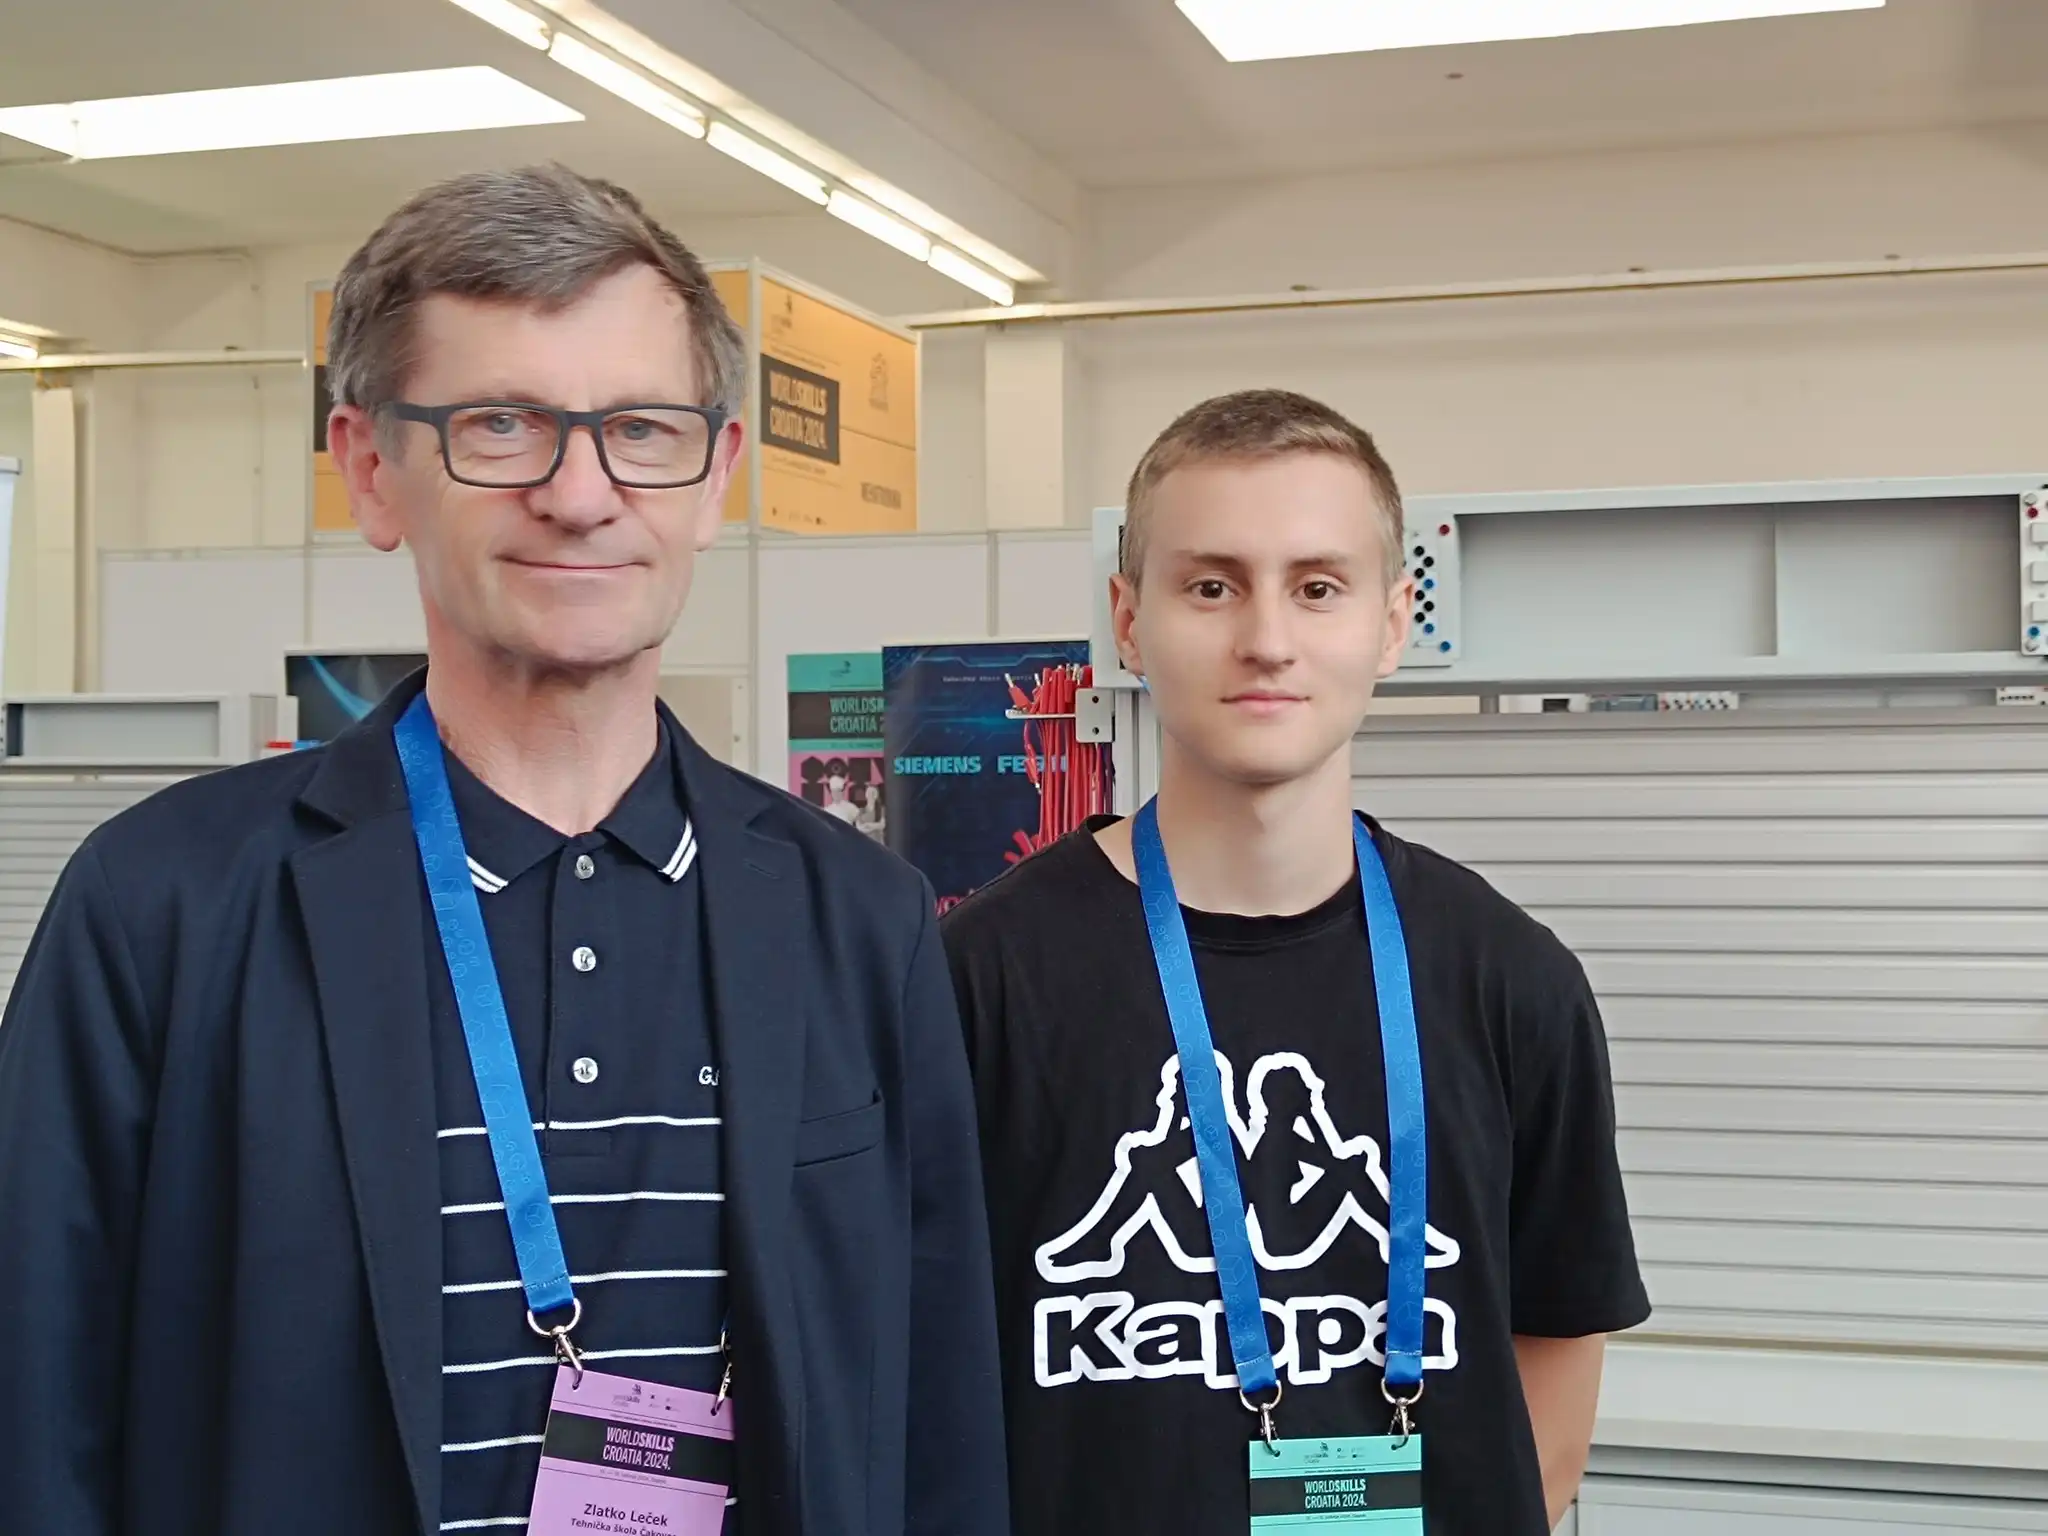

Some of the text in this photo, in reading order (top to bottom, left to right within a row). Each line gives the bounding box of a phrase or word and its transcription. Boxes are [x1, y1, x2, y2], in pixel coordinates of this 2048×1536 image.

[830, 715, 877, 733] CROATIA
[894, 755, 982, 775] SIEMENS
[606, 1426, 675, 1452] WORLDSKILLS
[602, 1444, 671, 1471] CROATIA 2024.
[1304, 1478, 1367, 1494] WORLDSKILLS
[1304, 1493, 1368, 1509] CROATIA 2024.
[583, 1503, 668, 1527] Zlatko Leček
[570, 1517, 611, 1532] Tehnička
[613, 1524, 637, 1536] škola
